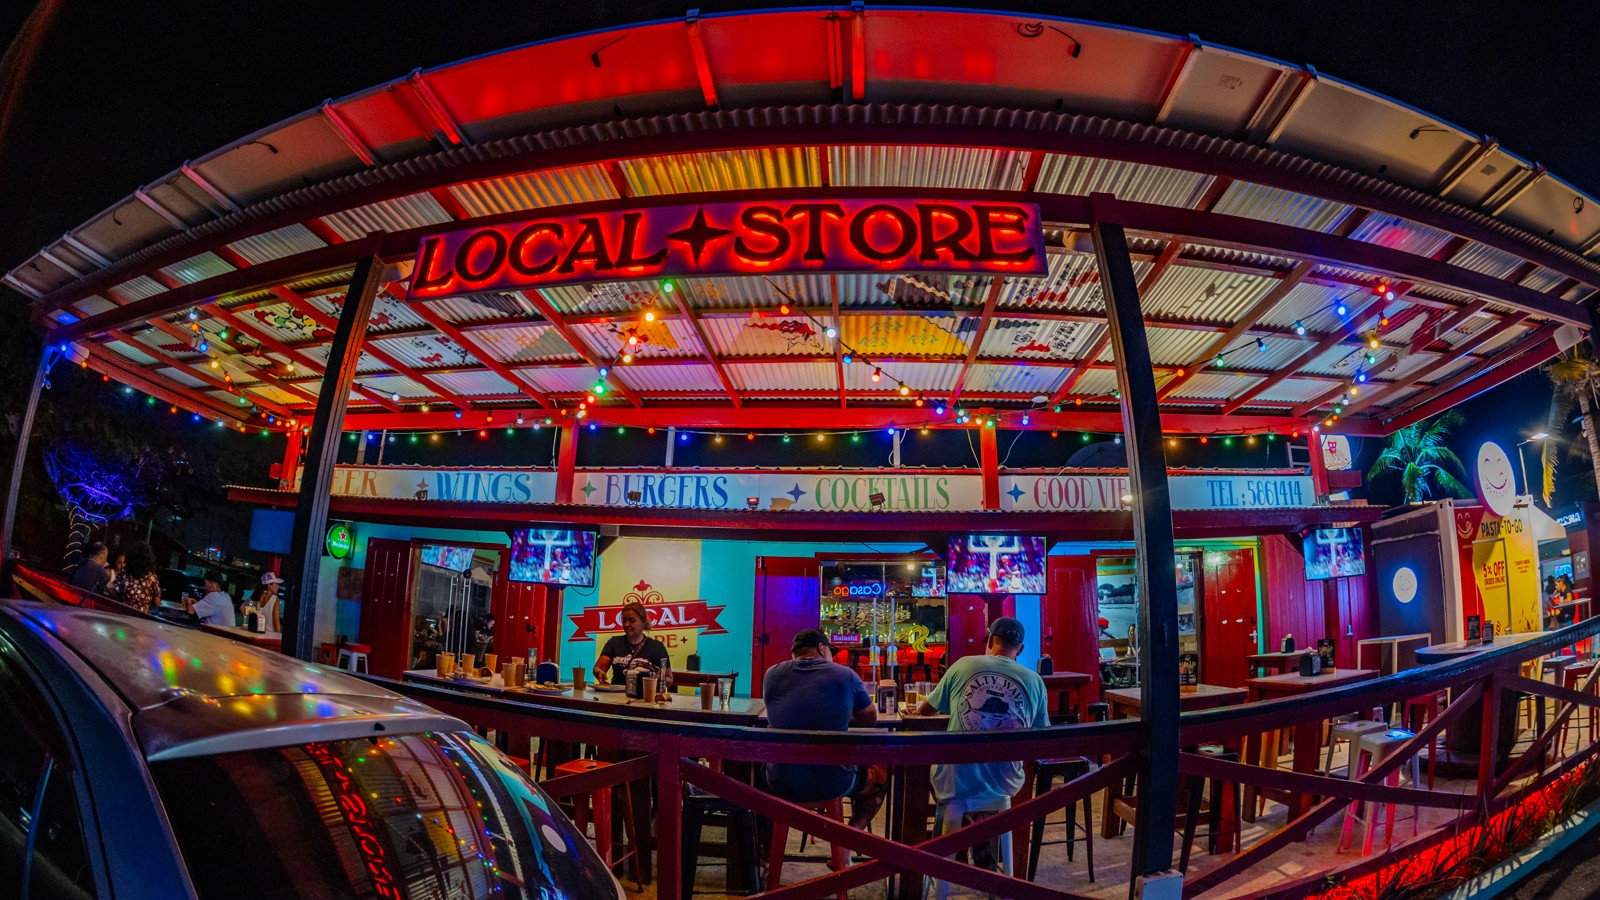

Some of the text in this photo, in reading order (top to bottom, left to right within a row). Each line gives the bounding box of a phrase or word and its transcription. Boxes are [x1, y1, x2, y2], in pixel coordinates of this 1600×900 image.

[413, 203, 1036, 291] LOCAL STORE
[330, 469, 379, 497] EER
[435, 472, 532, 503] WINGS
[604, 474, 729, 508] BURGERS
[815, 476, 951, 510] COCKTAILS
[1033, 477, 1130, 509] GOOD VIB
[1247, 480, 1304, 507] 5861414
[1481, 518, 1523, 538] PASTA-TO-GO
[1493, 561, 1505, 577] OFF
[964, 675, 999, 699] SALTY
